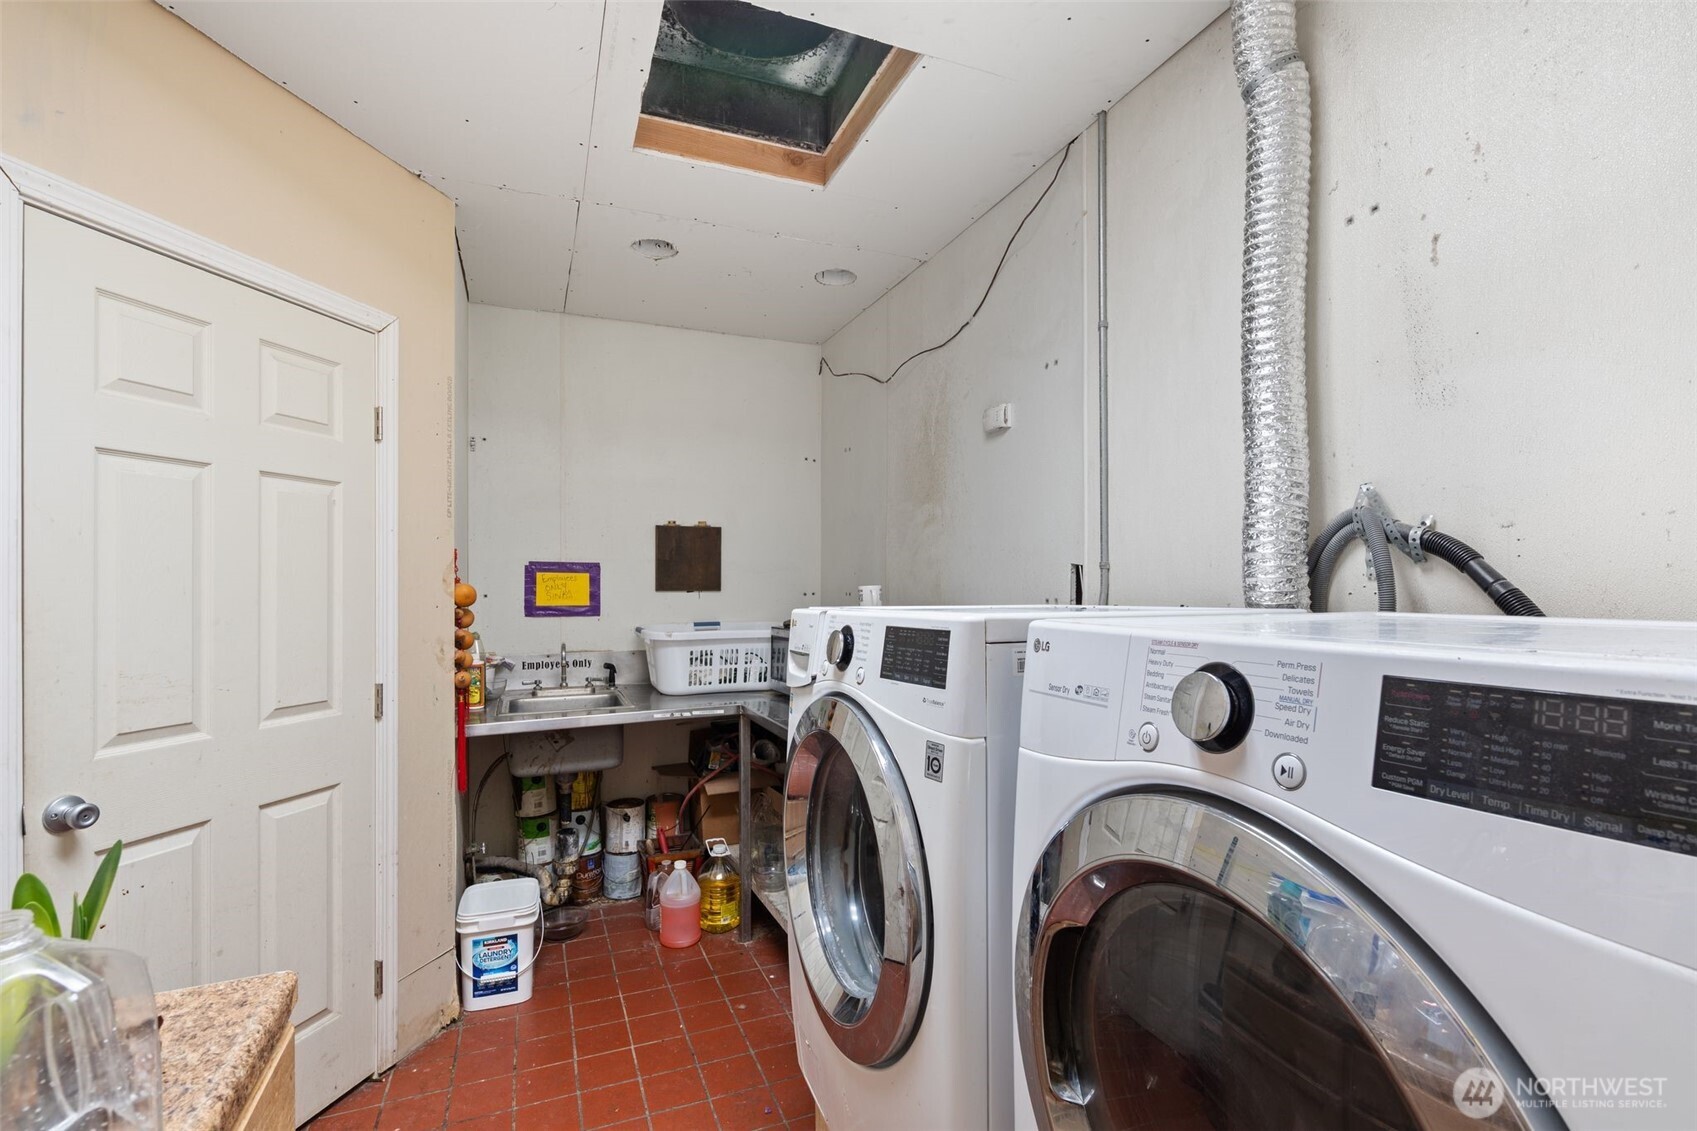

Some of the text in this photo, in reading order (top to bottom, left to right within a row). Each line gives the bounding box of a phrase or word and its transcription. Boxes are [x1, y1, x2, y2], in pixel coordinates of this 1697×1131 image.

[521, 659, 592, 670] Employes Only
[1149, 659, 1174, 668] Heavy Duty
[1147, 670, 1165, 679] Bedding
[1282, 673, 1315, 685] Delicates
[1048, 683, 1070, 696] Sensor Dry
[1146, 682, 1174, 691] Antibacterial
[1288, 686, 1314, 697] Towels
[1144, 693, 1157, 701] Steam
[1279, 695, 1313, 706] MANUAL DRY
[1142, 705, 1156, 713] Steam
[1275, 702, 1312, 716] Speed Dry
[1284, 718, 1310, 731] Air Dry
[1384, 715, 1430, 728] Reduce Static
[1653, 720, 1682, 732] More
[1264, 729, 1309, 744] Downloaded
[1382, 743, 1426, 757] Energy Saver
[1447, 748, 1473, 758] Normal
[1652, 756, 1679, 769] Less
[1381, 772, 1423, 787] Custom PGM
[1430, 784, 1470, 800] Dry Level
[1524, 803, 1570, 824] Time Dry
[1583, 816, 1623, 834] Signal
[1637, 824, 1666, 838] Damp
[479, 948, 513, 959] LAUNDRY
[480, 955, 512, 963] DETERGENT
